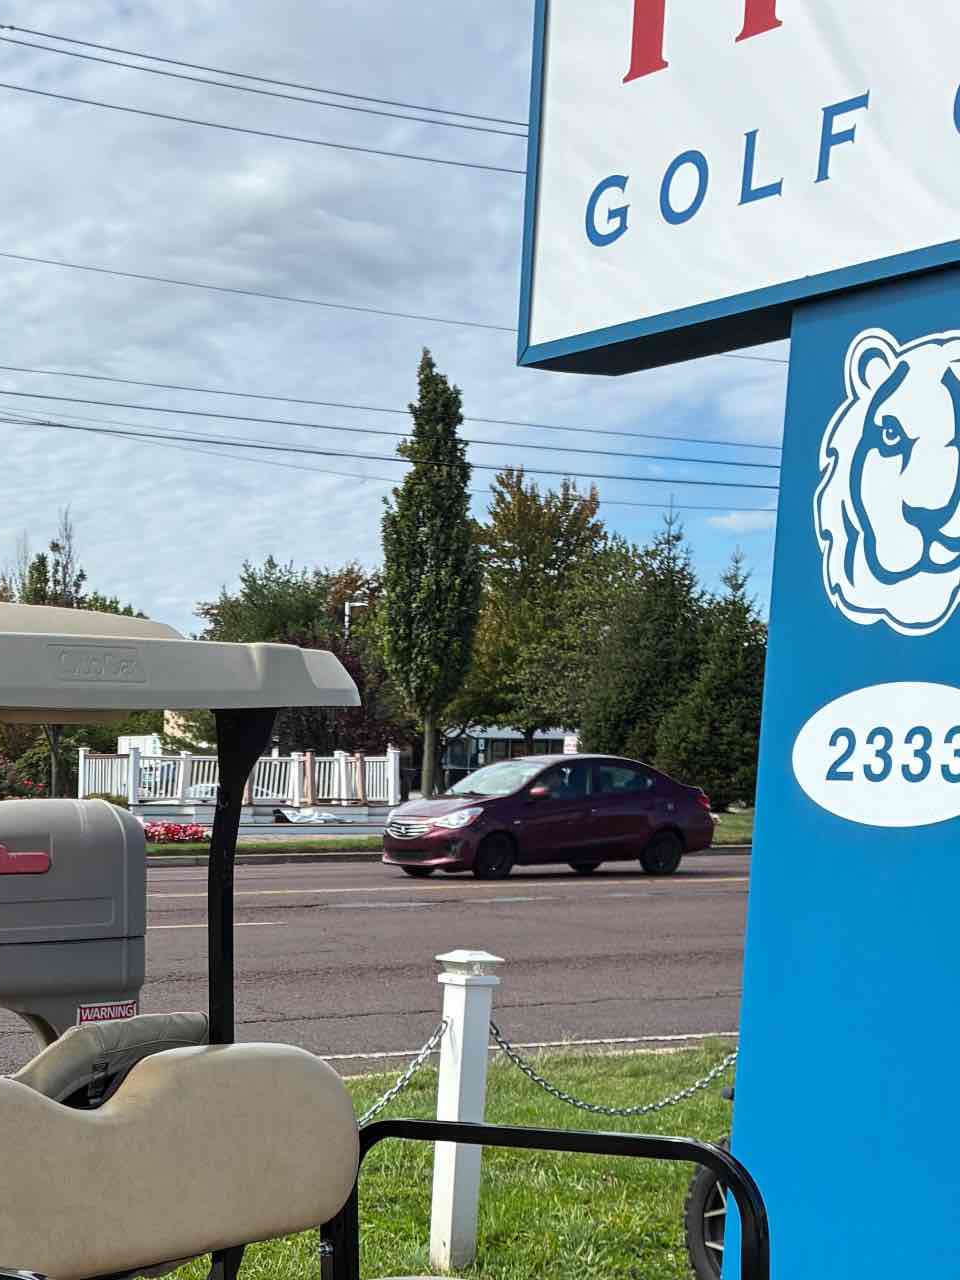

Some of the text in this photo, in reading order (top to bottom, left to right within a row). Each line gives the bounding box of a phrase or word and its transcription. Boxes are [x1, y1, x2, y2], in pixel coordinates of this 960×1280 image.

[585, 89, 870, 247] GOLF
[825, 725, 960, 783] 2333
[81, 1005, 133, 1019] WARNING
